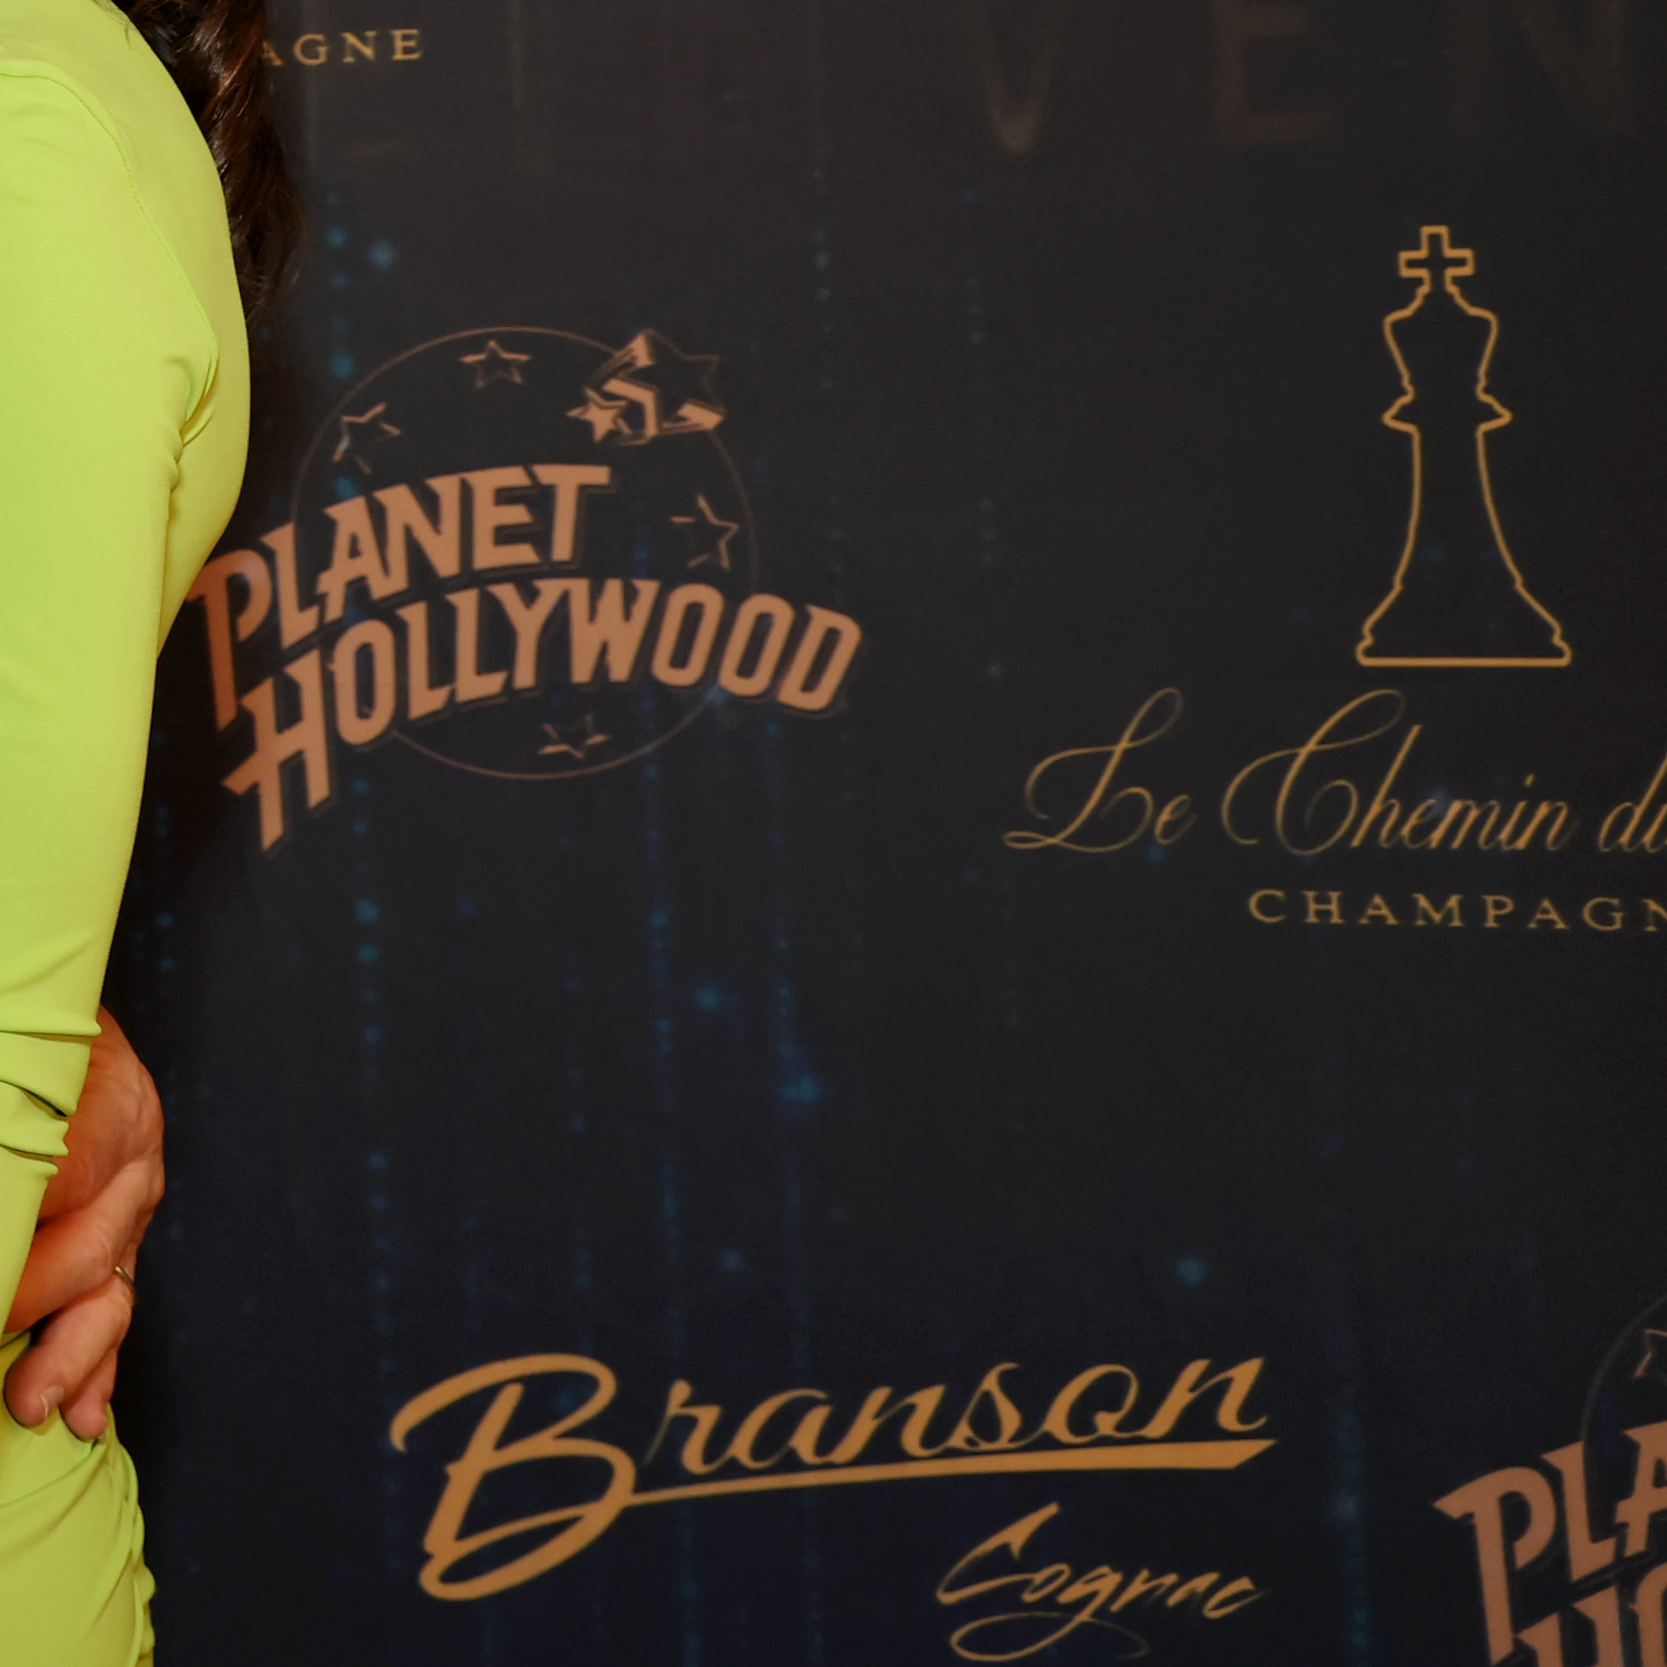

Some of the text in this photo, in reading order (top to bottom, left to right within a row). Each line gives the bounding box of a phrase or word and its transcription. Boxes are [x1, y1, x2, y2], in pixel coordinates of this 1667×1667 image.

[185, 463, 611, 732] PLANET
[221, 577, 863, 852] HOLLYWOOD
[1004, 687, 1197, 854] Le
[1221, 688, 1574, 856] Chemin
[390, 1352, 1278, 1600] Branson
